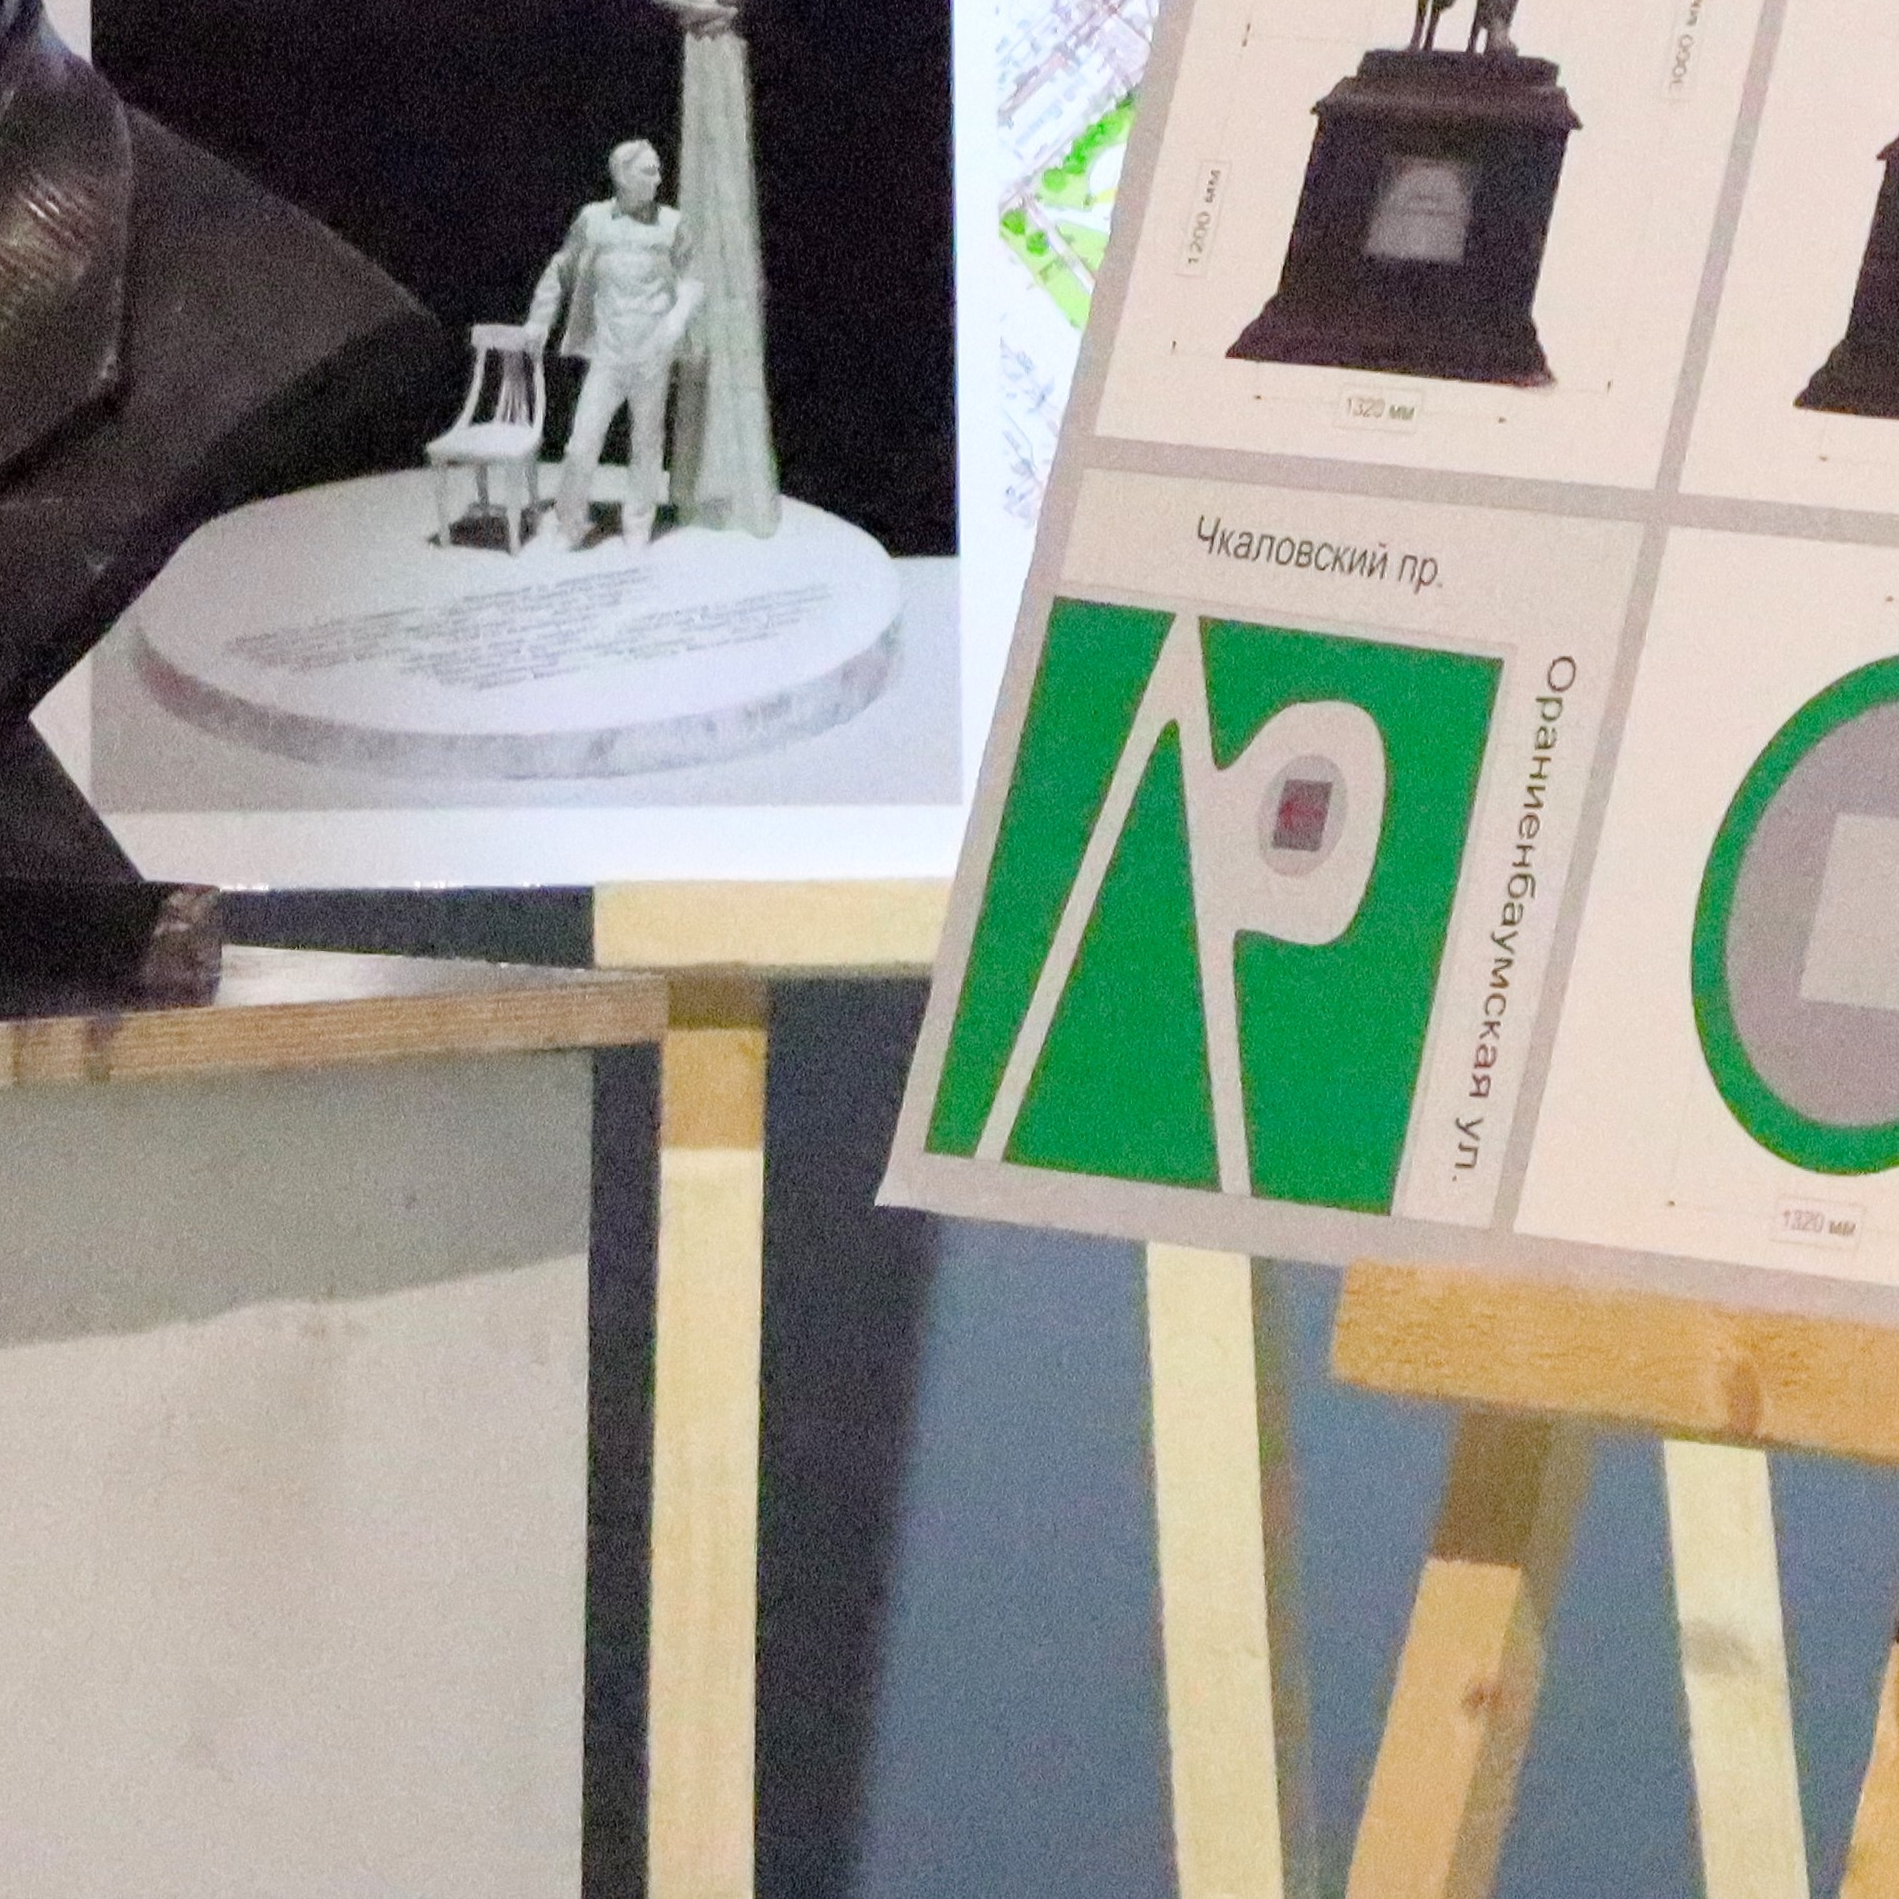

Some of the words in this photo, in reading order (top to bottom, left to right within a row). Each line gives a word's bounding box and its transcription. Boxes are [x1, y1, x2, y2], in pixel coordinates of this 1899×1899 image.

[1196, 514, 1388, 579] Чкаловский
[1398, 552, 1444, 591] пр.
[1468, 655, 1578, 1100] Ораниенбаумская
[1450, 1116, 1490, 1183] ул.
